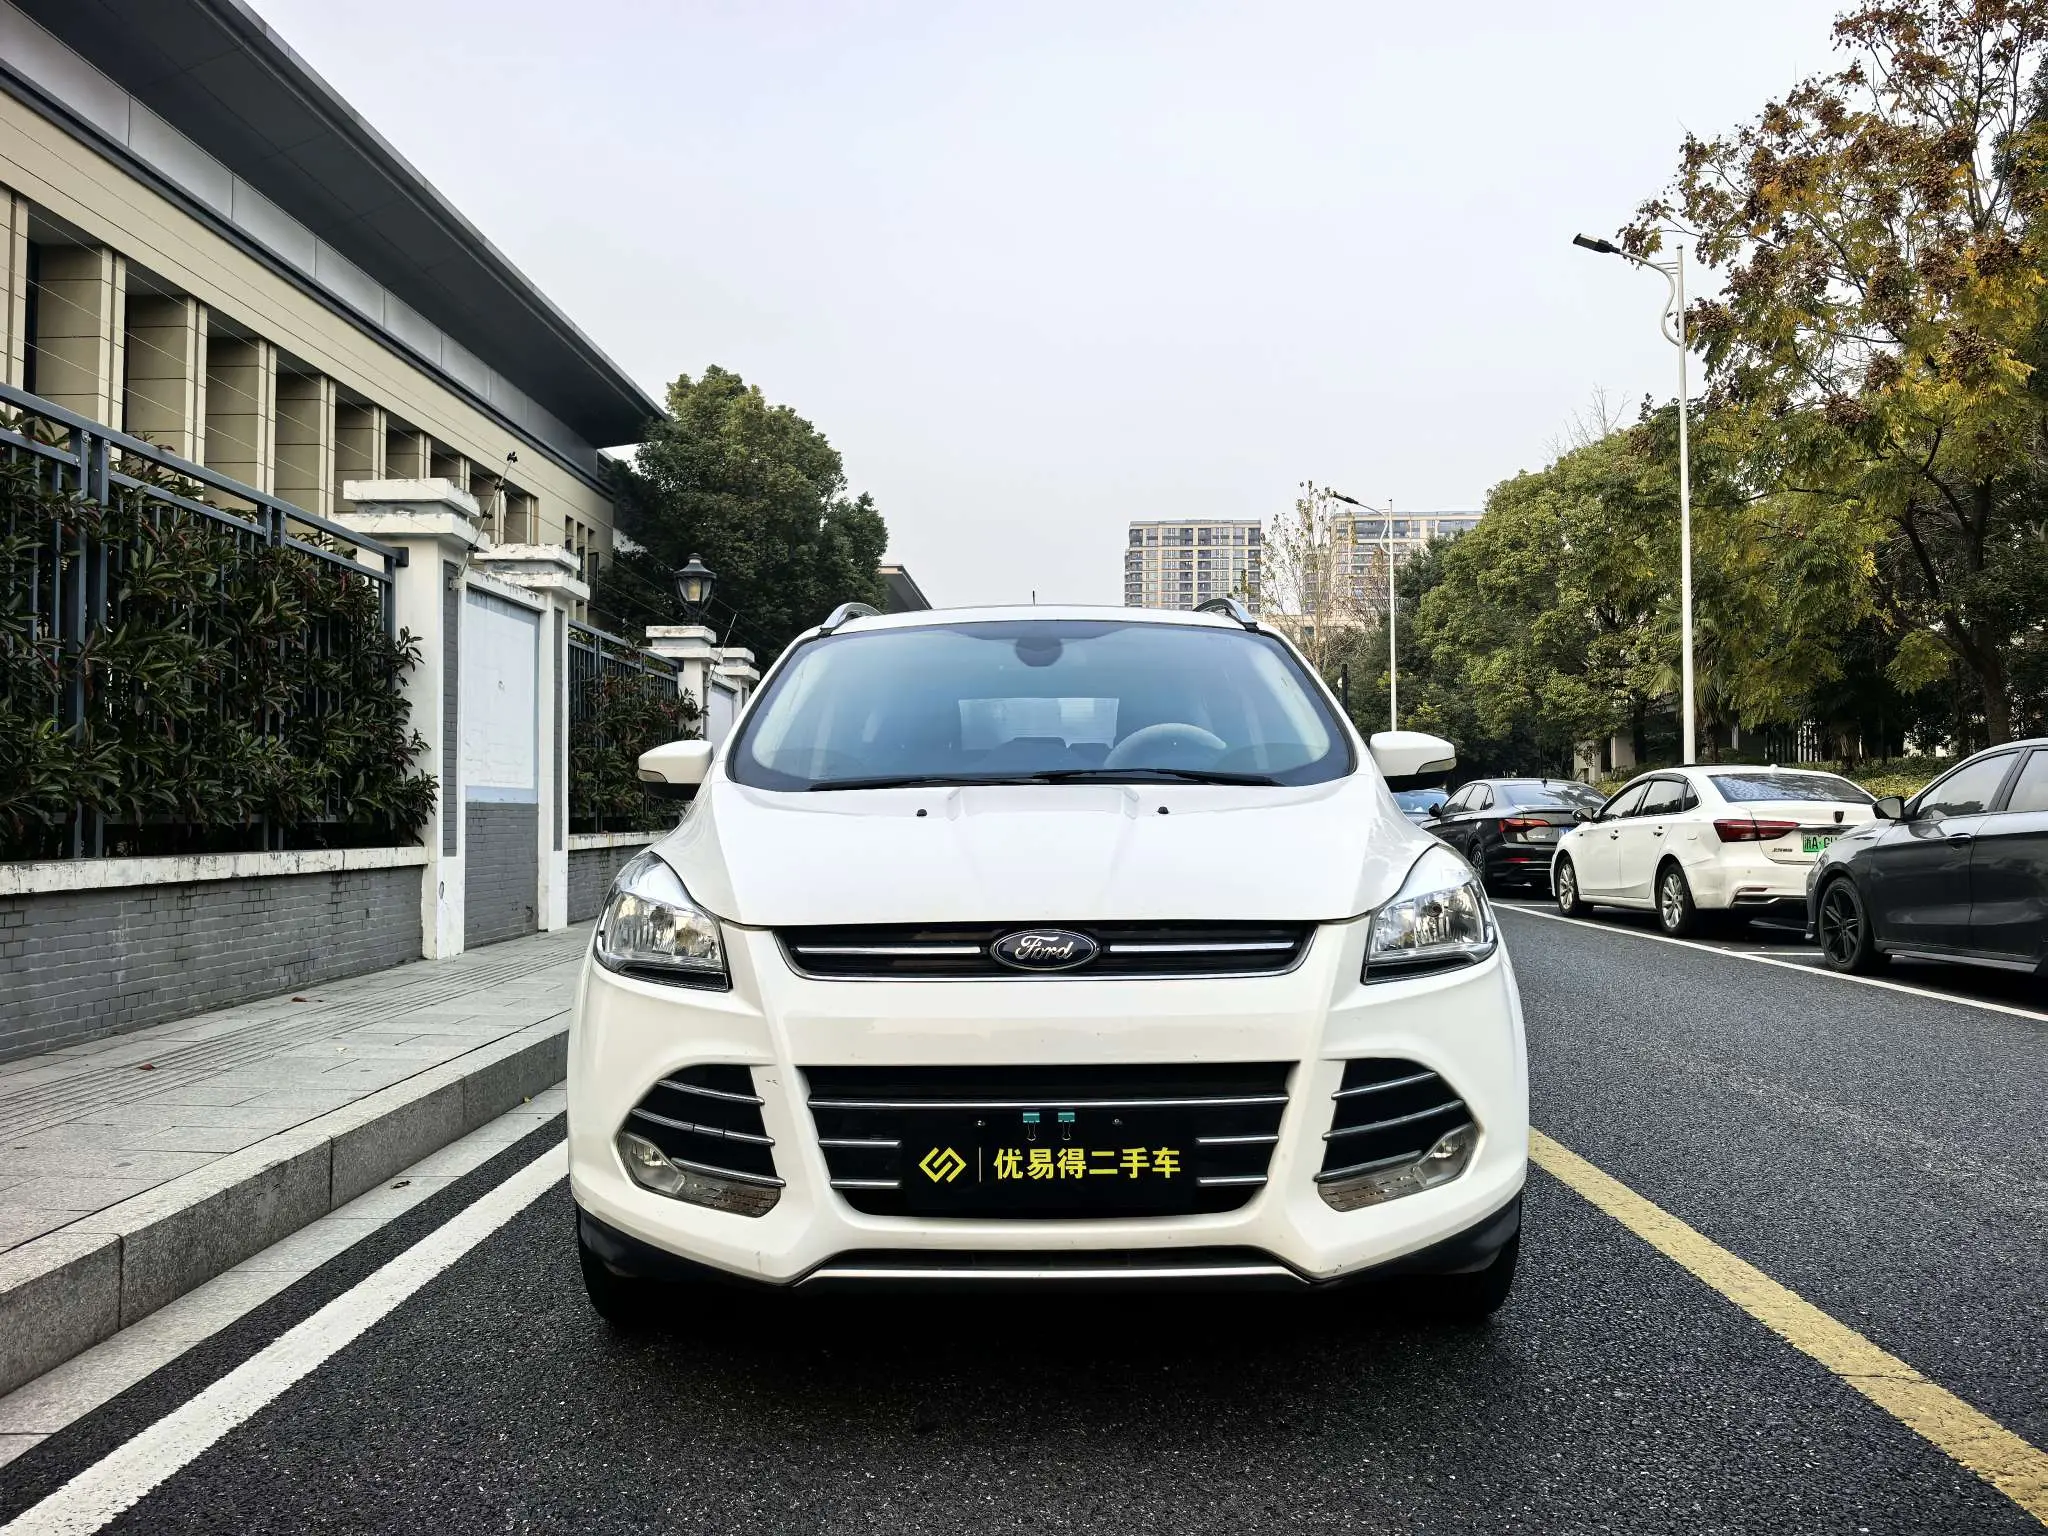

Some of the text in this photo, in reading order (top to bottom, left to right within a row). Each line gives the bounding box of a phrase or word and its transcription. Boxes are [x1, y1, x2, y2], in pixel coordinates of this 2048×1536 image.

[1015, 935, 1073, 960] Ford
[993, 1146, 1181, 1180] 优易得二手车
